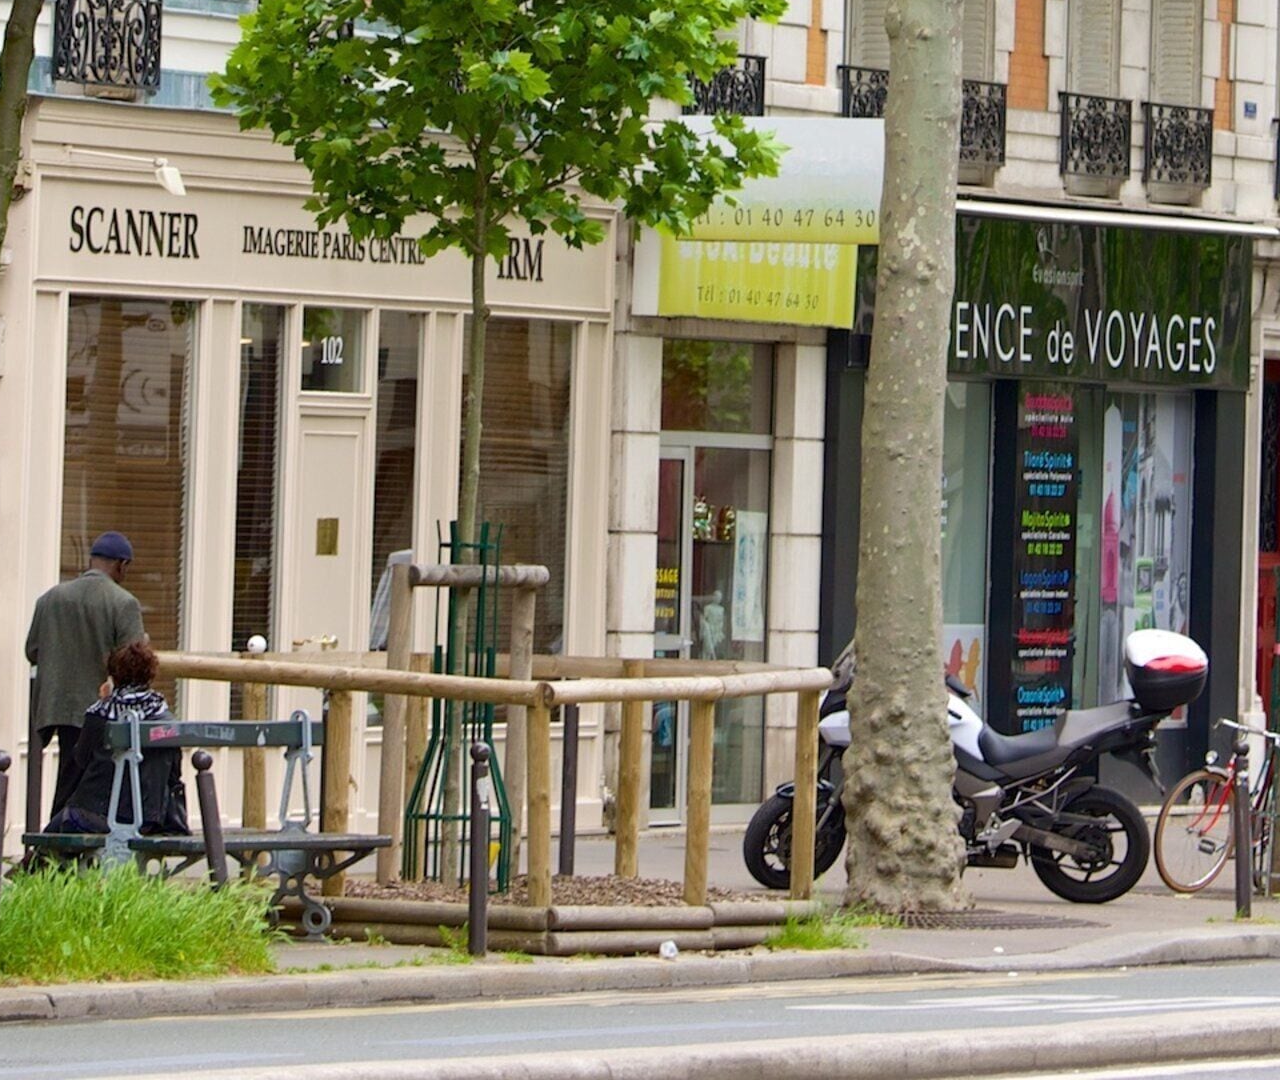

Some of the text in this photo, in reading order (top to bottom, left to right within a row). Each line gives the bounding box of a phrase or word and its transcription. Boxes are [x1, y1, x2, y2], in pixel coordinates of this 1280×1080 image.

[69, 205, 200, 259] SCANNER
[735, 208, 751, 226] 01
[762, 208, 784, 226] 40
[794, 209, 815, 227] 47
[824, 209, 845, 227] 64
[855, 209, 876, 228] 30
[242, 226, 320, 258] IMAGERIE
[322, 231, 365, 262] PARIS
[728, 289, 741, 305] 01
[746, 289, 762, 306] 40
[767, 291, 782, 308] 47
[785, 293, 800, 309] 64
[805, 294, 819, 310] 30
[321, 336, 343, 364] 102
[956, 302, 1216, 374] ENCE de VOYAGES
